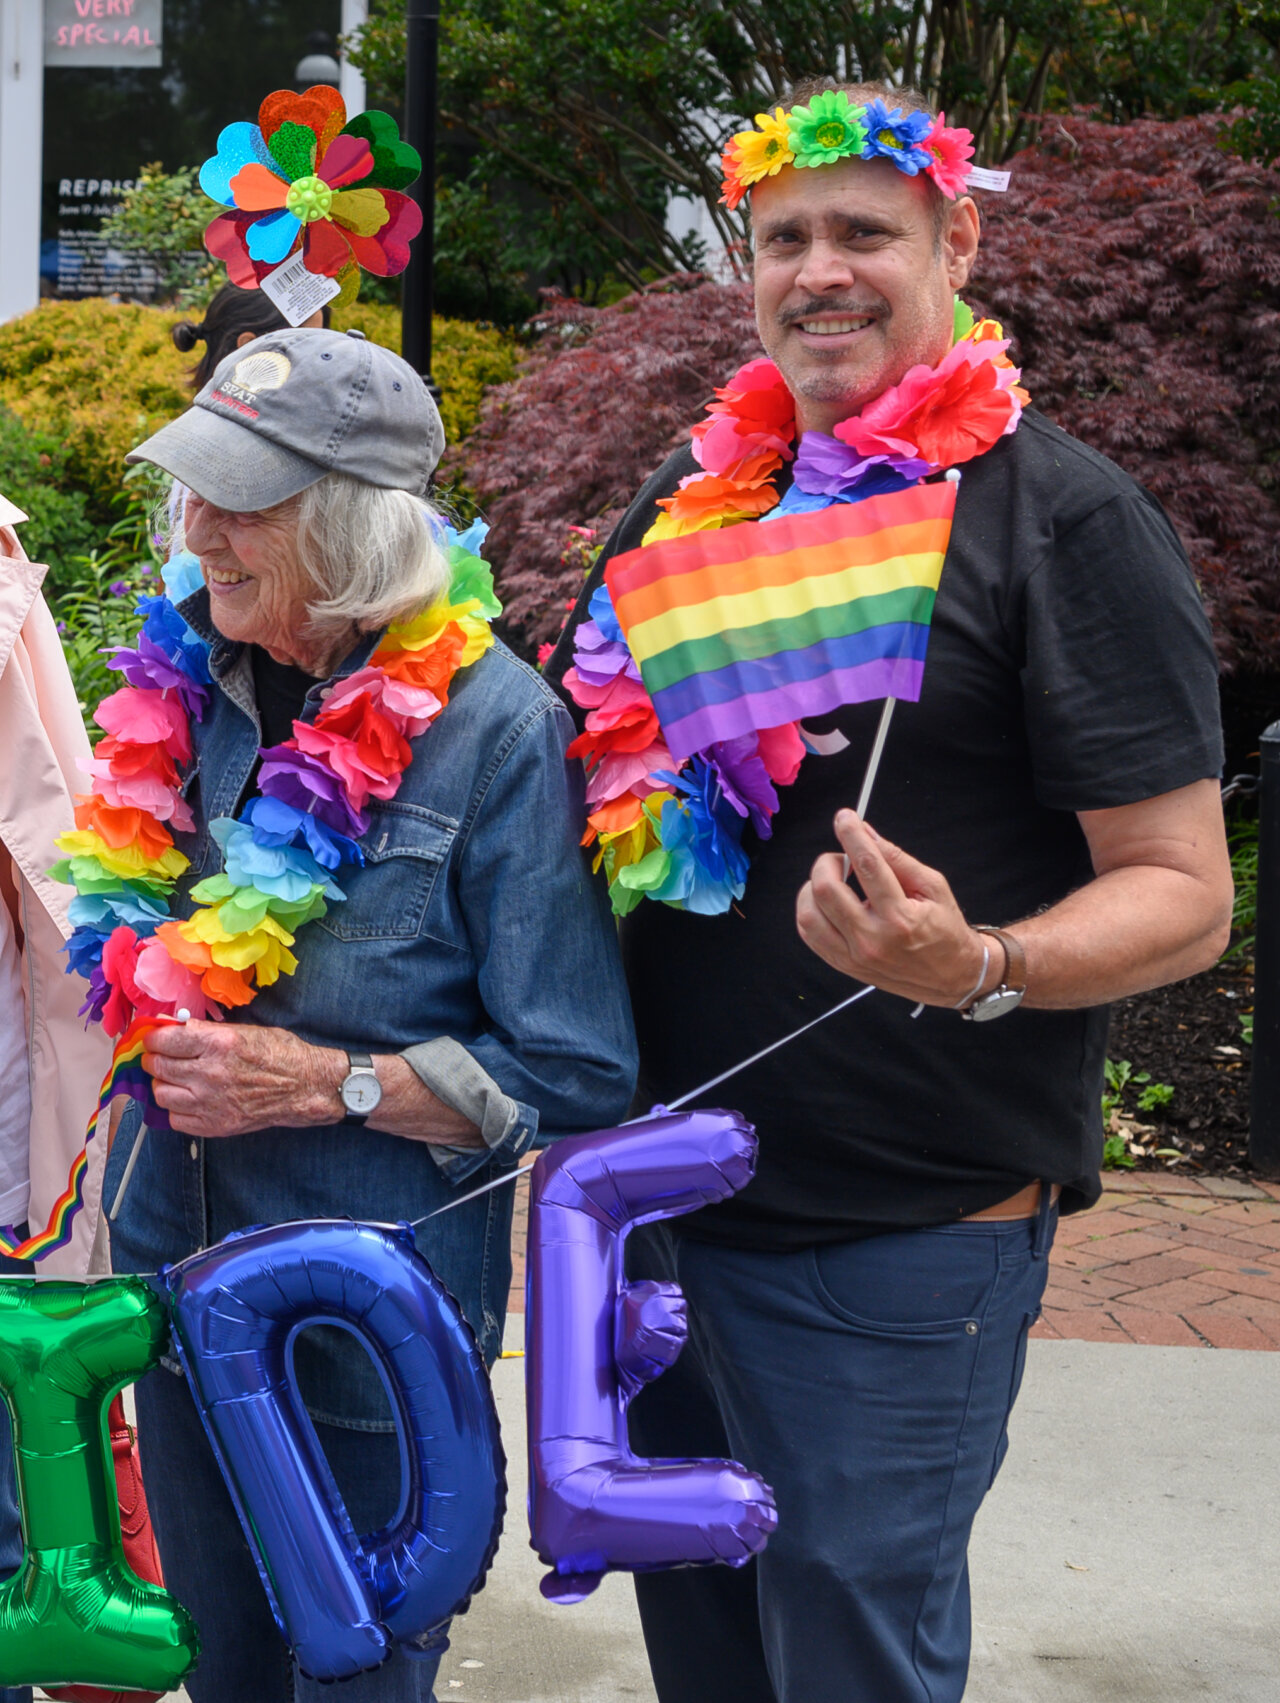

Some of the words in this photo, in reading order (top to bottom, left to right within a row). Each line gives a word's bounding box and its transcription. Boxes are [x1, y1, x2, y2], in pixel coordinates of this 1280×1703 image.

[74, 0, 134, 18] VERY
[56, 23, 154, 47] SPECIAL
[220, 381, 257, 405] SPAT
